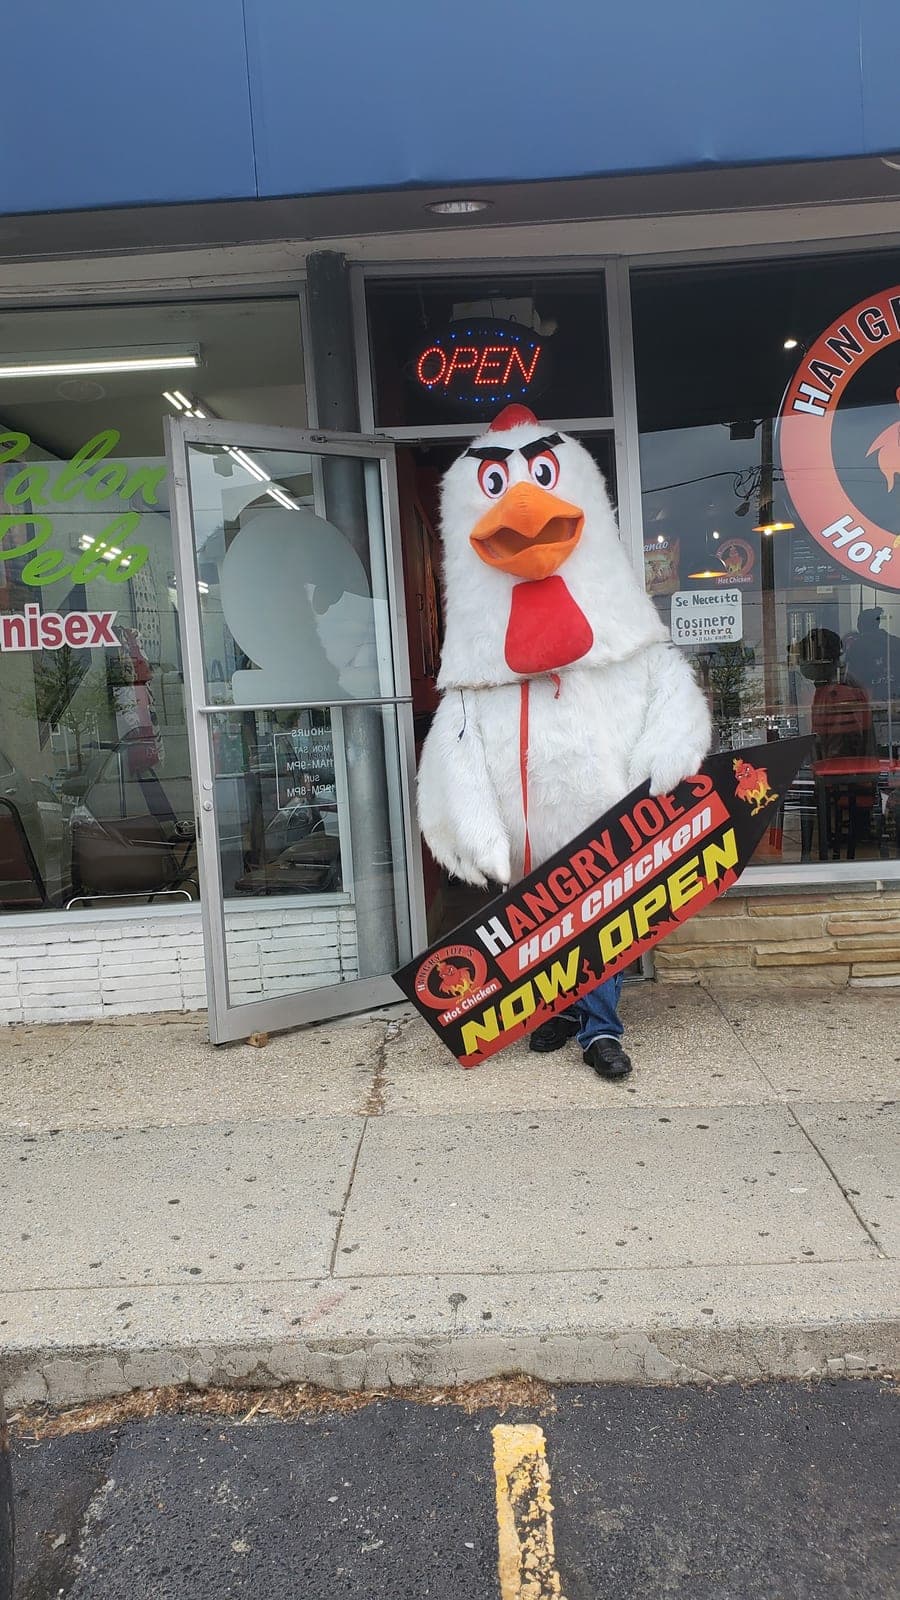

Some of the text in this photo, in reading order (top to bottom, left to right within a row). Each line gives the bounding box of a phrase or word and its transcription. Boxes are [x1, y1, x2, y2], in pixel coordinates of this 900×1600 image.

[417, 346, 541, 385] OPEN
[821, 514, 892, 575] Hot
[675, 596, 689, 607] Se
[675, 615, 736, 630] Cosinero
[474, 773, 713, 958] HANGRY JOES
[518, 806, 712, 971] Hot Chicken
[460, 827, 739, 1056] NOW OPEN
[443, 982, 497, 1023] Hot Chicken
